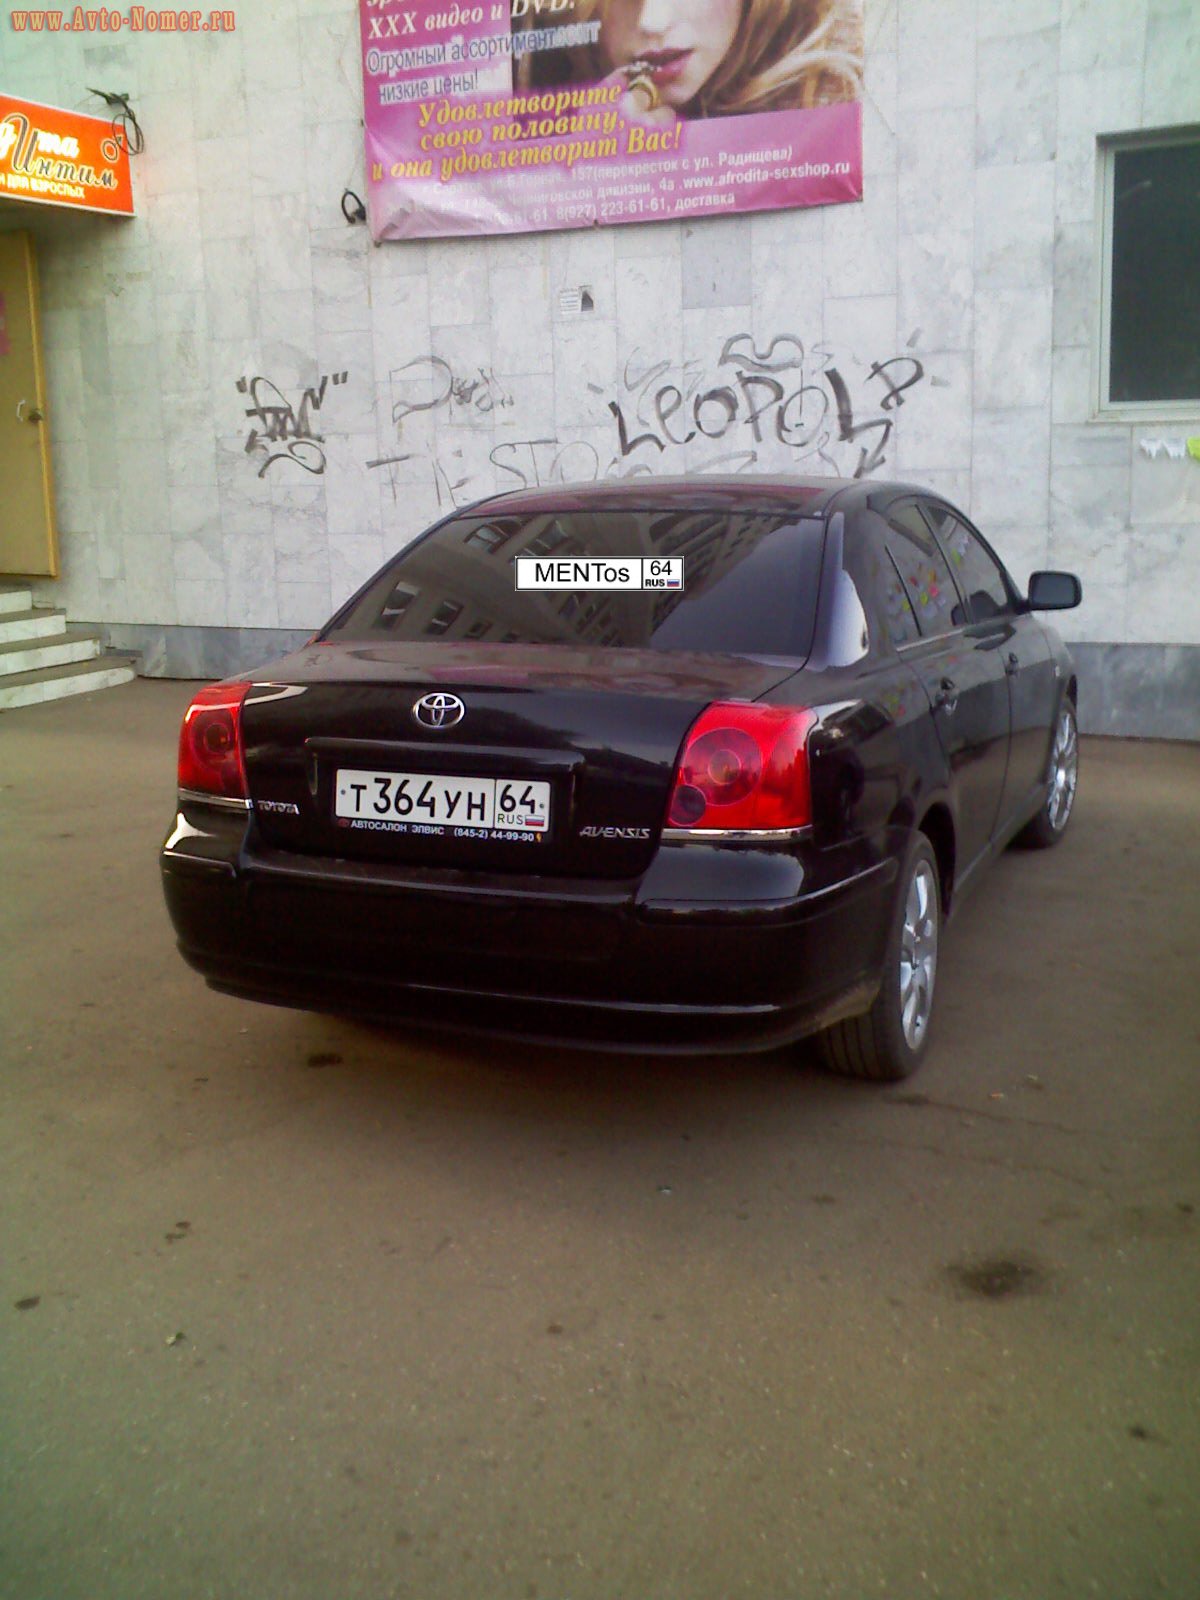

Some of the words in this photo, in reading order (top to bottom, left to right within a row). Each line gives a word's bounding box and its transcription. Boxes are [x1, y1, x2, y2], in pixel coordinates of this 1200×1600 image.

[424, 8, 483, 32] видео
[490, 5, 502, 19] и
[367, 44, 446, 76] Огромный
[451, 29, 555, 63] ассортимент
[434, 68, 478, 96] цены!
[419, 84, 622, 128] Удовлетворите
[420, 127, 482, 151] свою
[492, 110, 625, 144] половину,
[372, 163, 383, 182] и
[390, 159, 432, 179] она
[441, 136, 617, 183] удовлетворит
[627, 122, 683, 154] Вас!
[694, 156, 713, 172] ул.
[719, 145, 793, 168] Радищева)
[675, 192, 735, 212] доставка
[258, 800, 300, 815] TOYOTA
[500, 784, 536, 814] 64
[350, 819, 407, 833] АВТОСАЛОН
[454, 827, 488, 840] (845-2)
[490, 830, 534, 843] 44-99-90
[497, 813, 524, 826] RUS
[579, 826, 651, 839] AVENSIS
